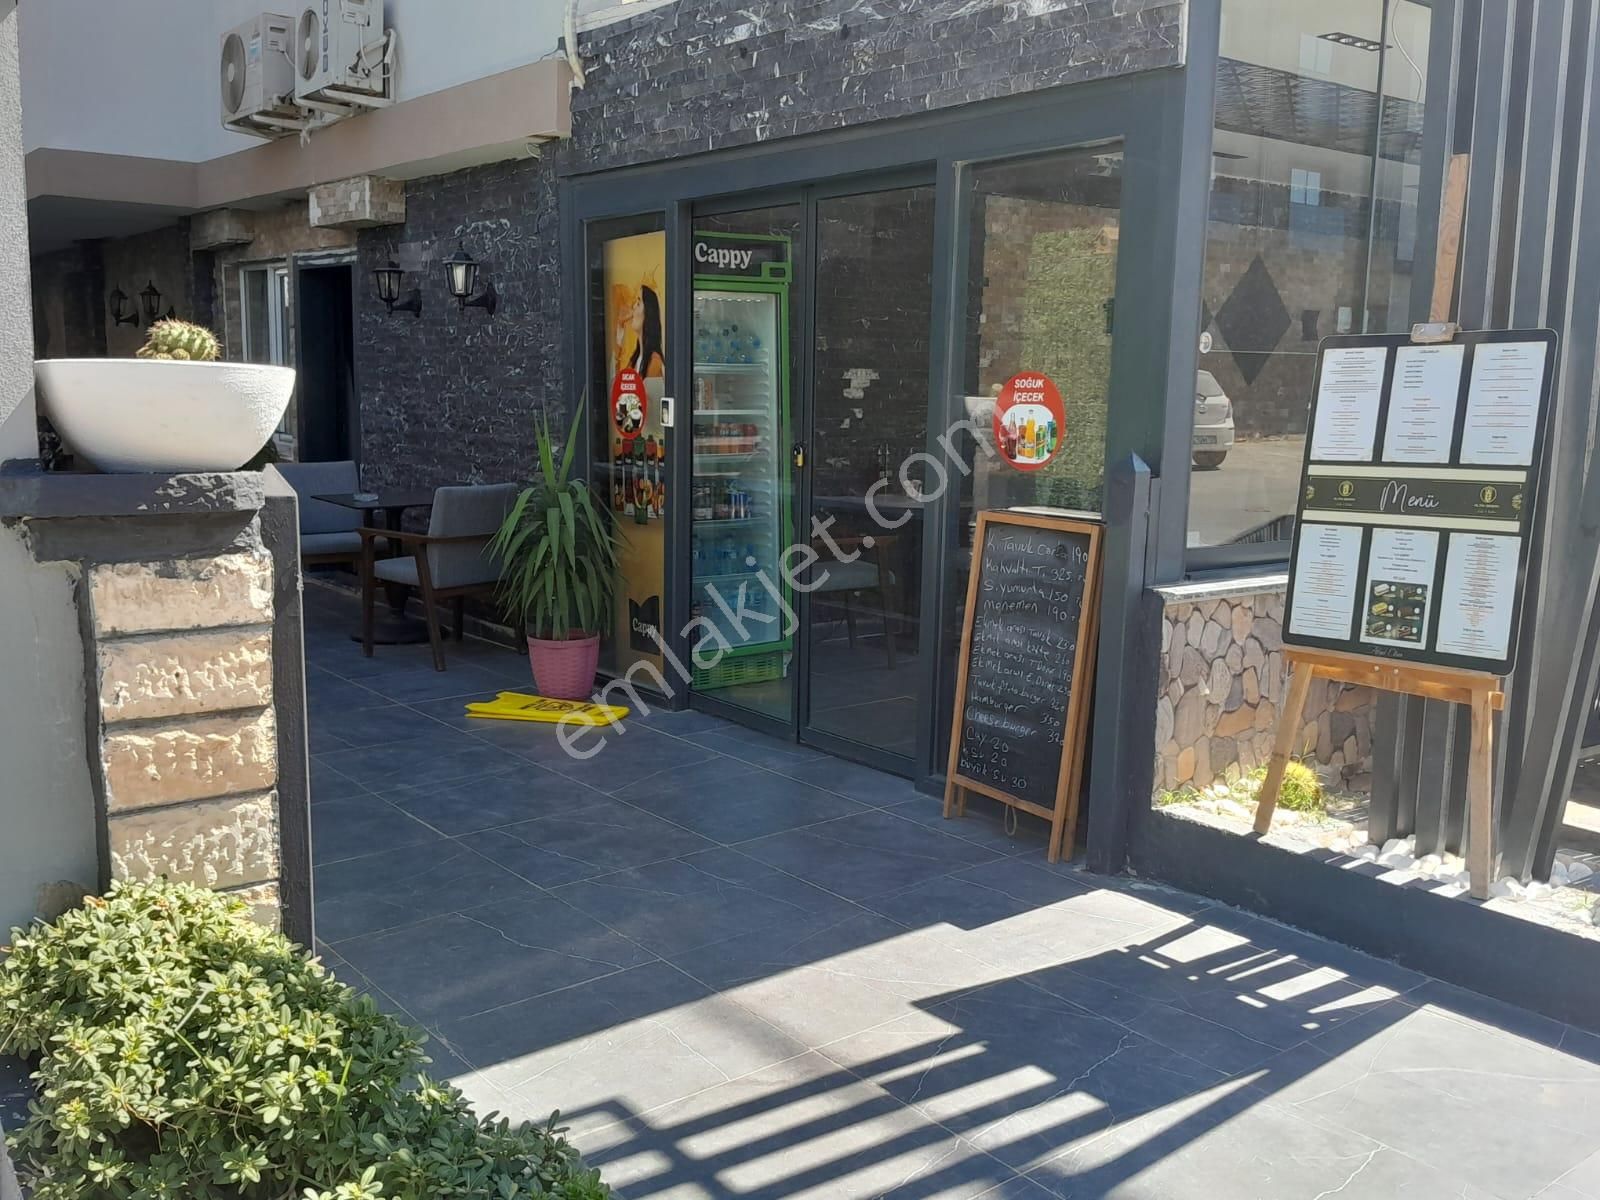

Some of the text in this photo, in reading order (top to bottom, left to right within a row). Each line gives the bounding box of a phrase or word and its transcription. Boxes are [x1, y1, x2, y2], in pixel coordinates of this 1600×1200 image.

[695, 242, 753, 269] Cappy
[1014, 377, 1045, 389] SOĞUK
[1013, 391, 1045, 403] İÇECEK
[1379, 480, 1440, 513] Menü
[1072, 547, 1088, 564] 190
[1048, 607, 1068, 621] 190
[991, 737, 1009, 753] 20
[991, 752, 1008, 767] 20
[1011, 776, 1028, 790] 30
